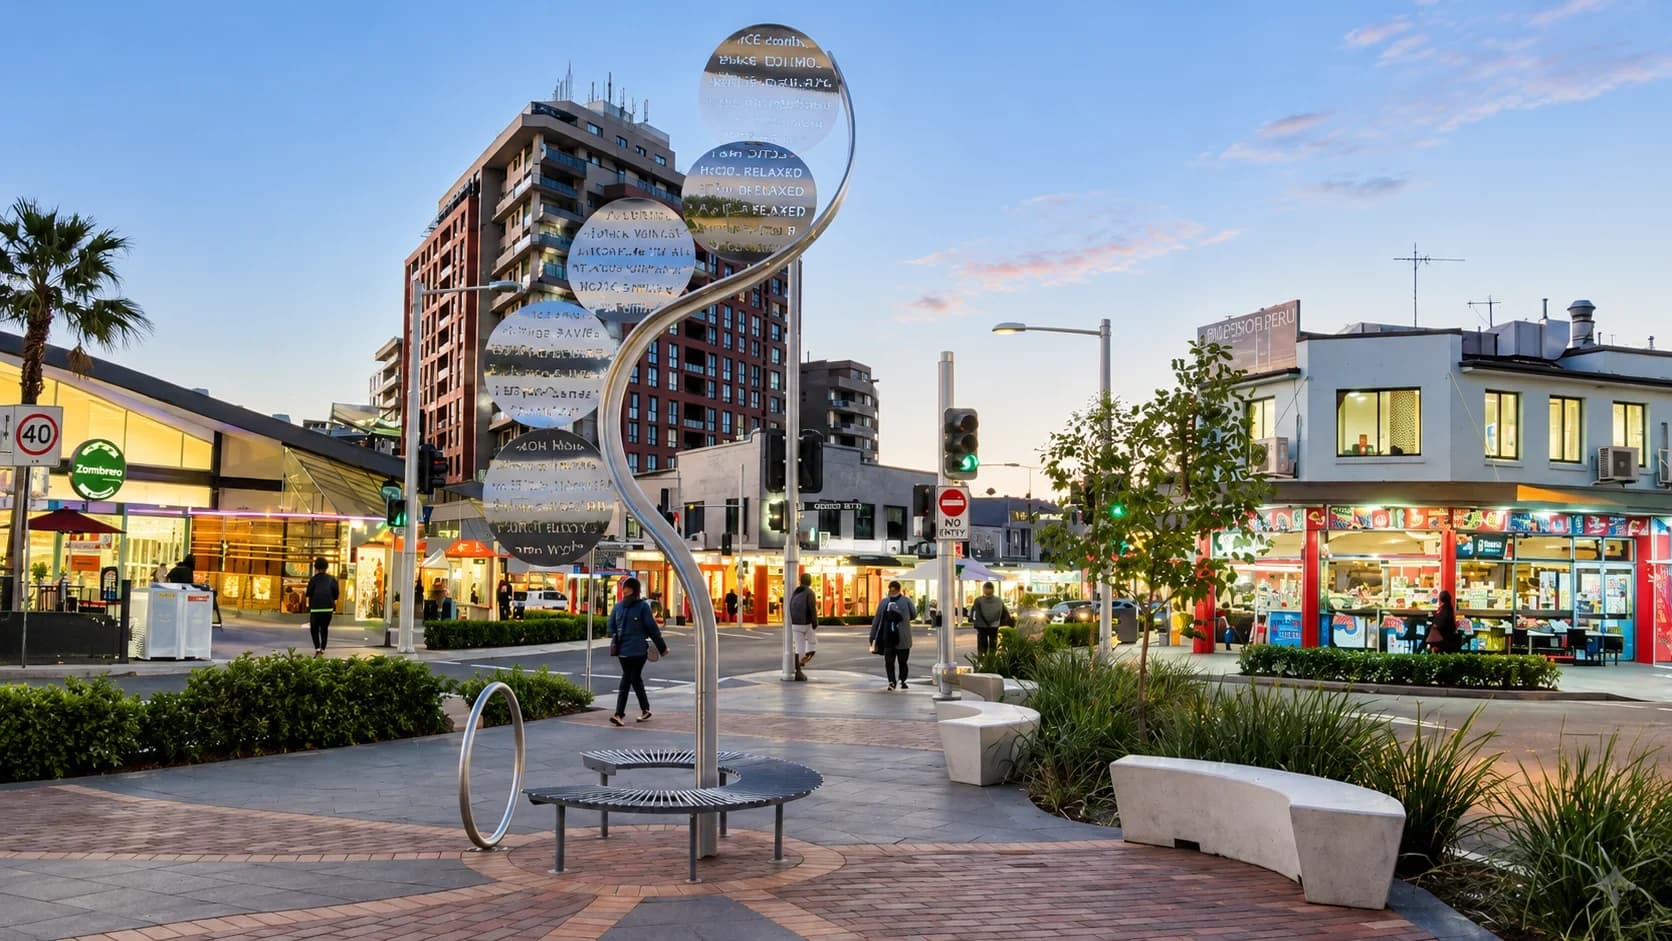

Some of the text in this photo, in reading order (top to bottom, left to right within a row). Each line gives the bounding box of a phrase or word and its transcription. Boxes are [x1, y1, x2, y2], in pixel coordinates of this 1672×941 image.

[1264, 307, 1295, 330] PERU
[22, 424, 51, 444] 40
[945, 518, 961, 527] NO
